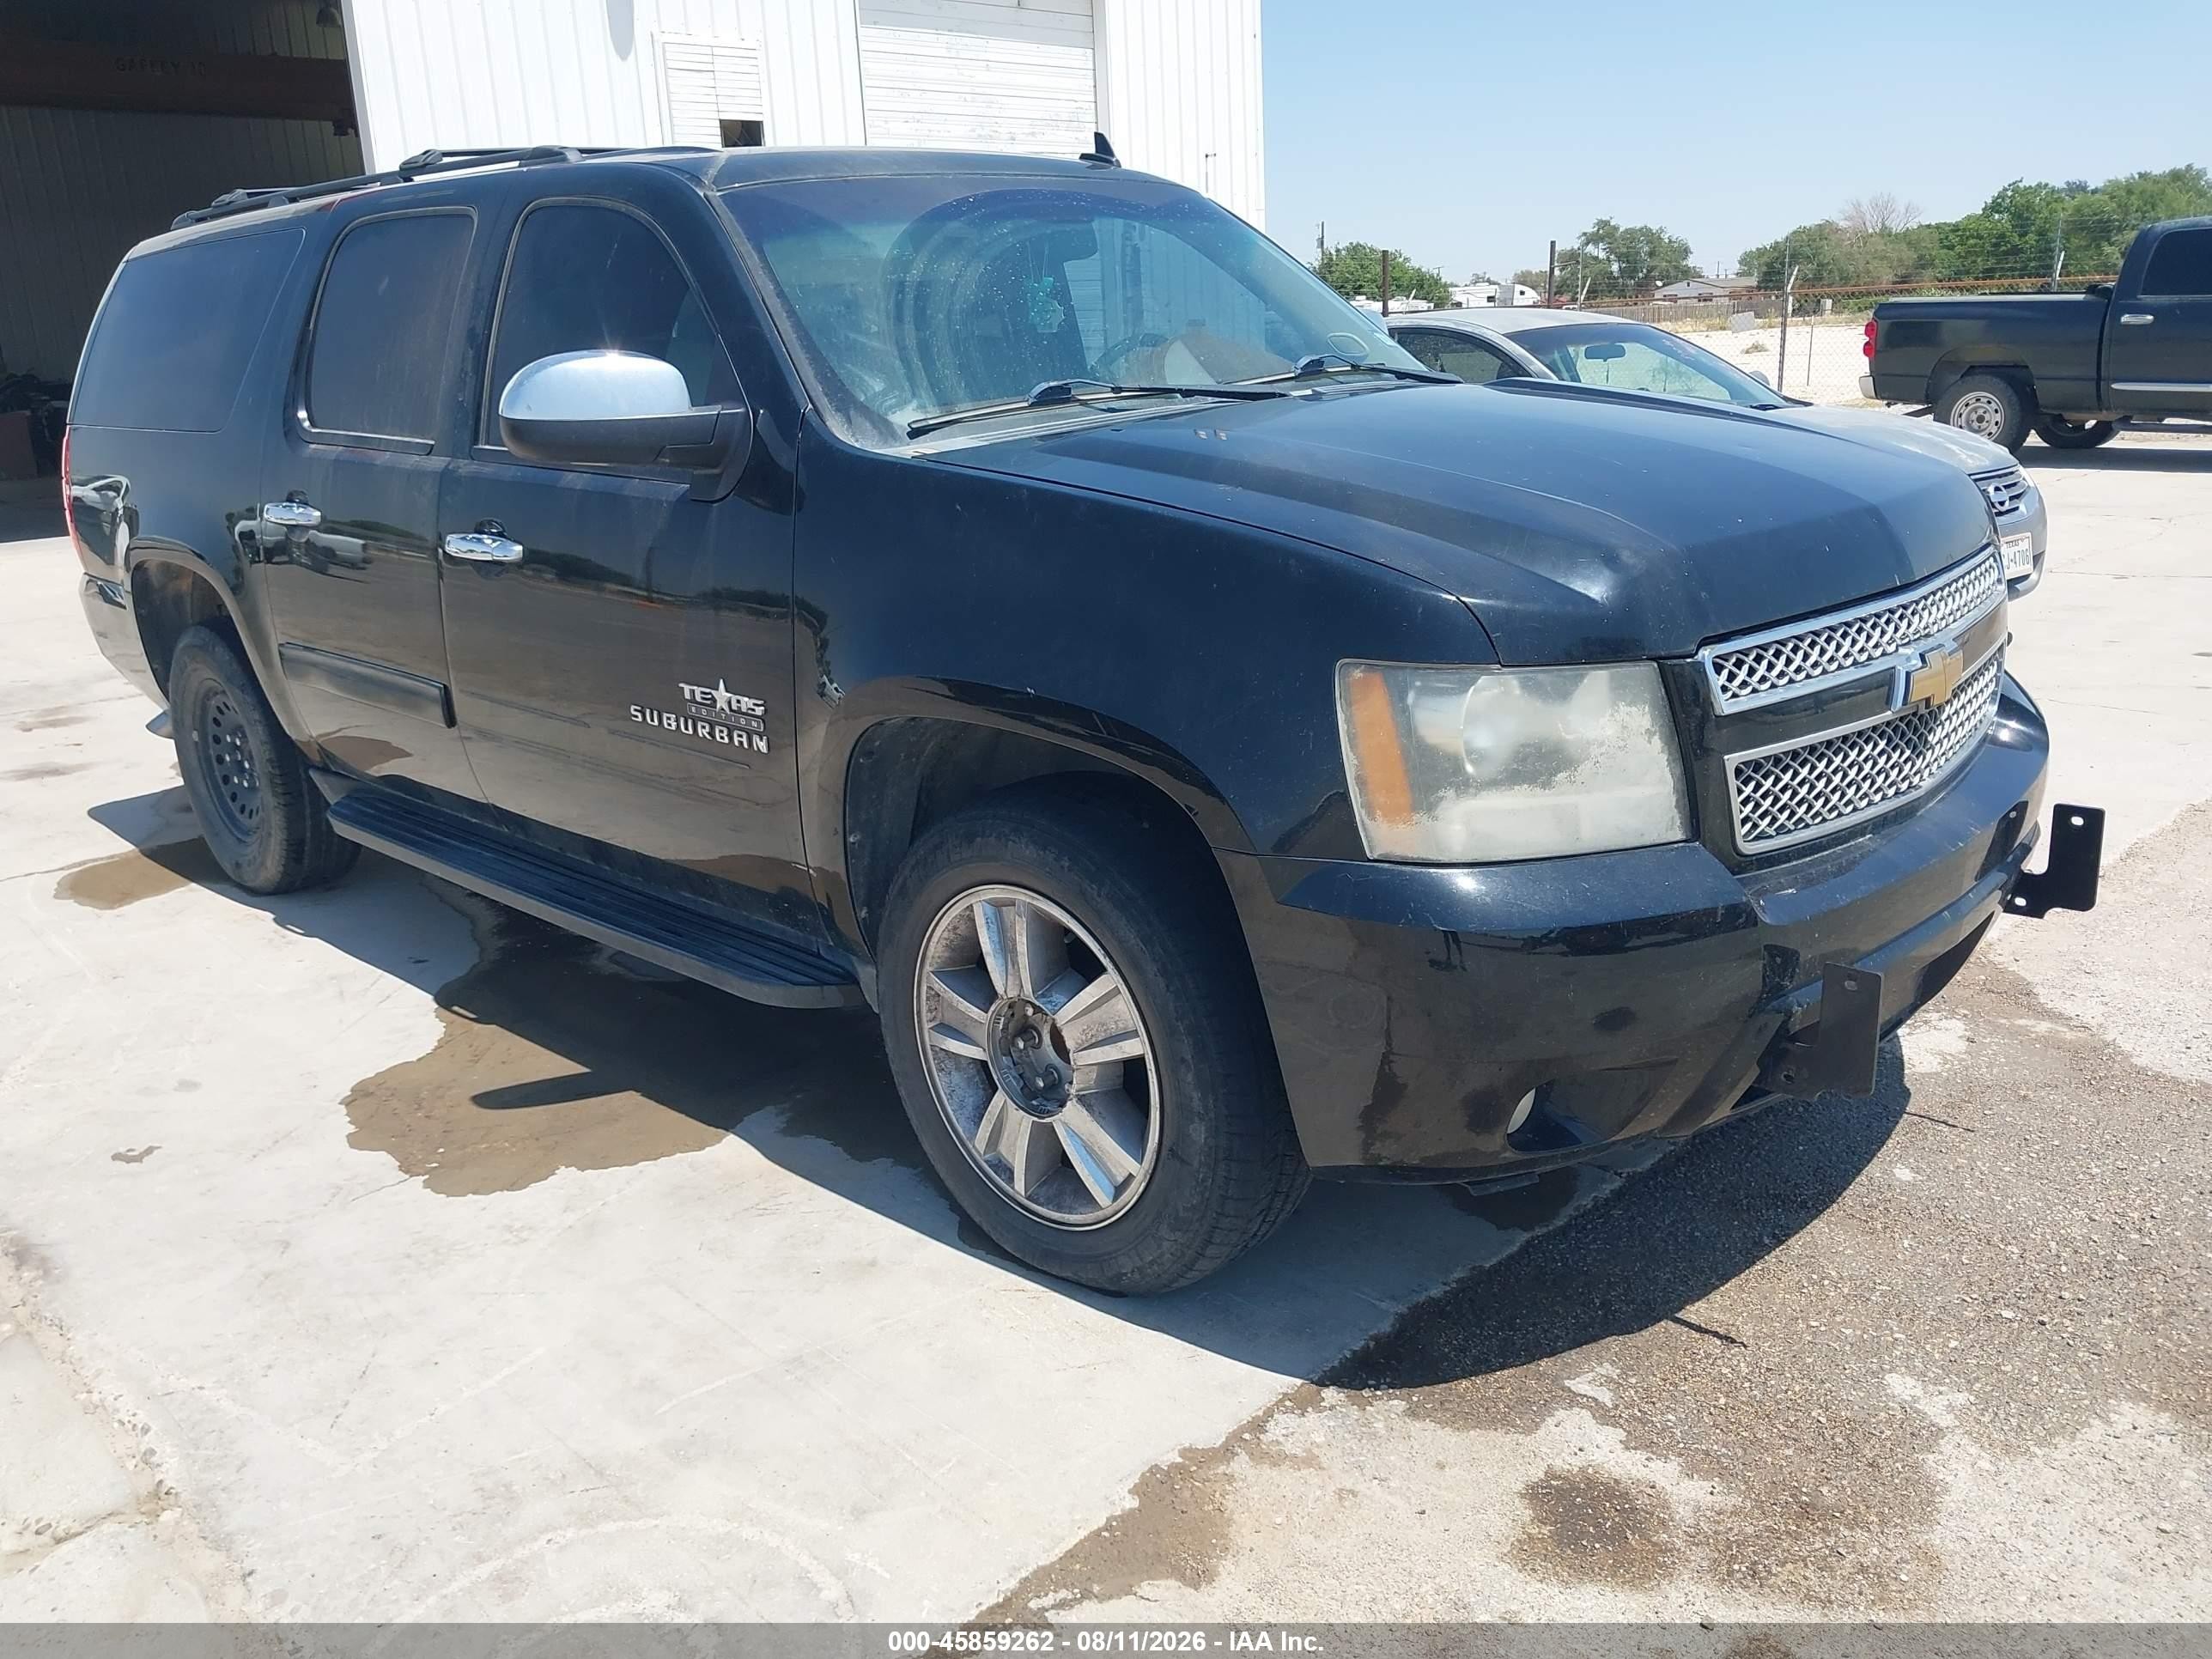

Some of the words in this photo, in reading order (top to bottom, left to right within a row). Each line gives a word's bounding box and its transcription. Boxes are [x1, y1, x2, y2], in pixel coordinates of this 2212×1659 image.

[2006, 539, 2020, 549] TEXAS
[678, 678, 765, 716] TEXAS
[629, 704, 769, 754] SUBURBAN
[690, 704, 761, 729] EDITION
